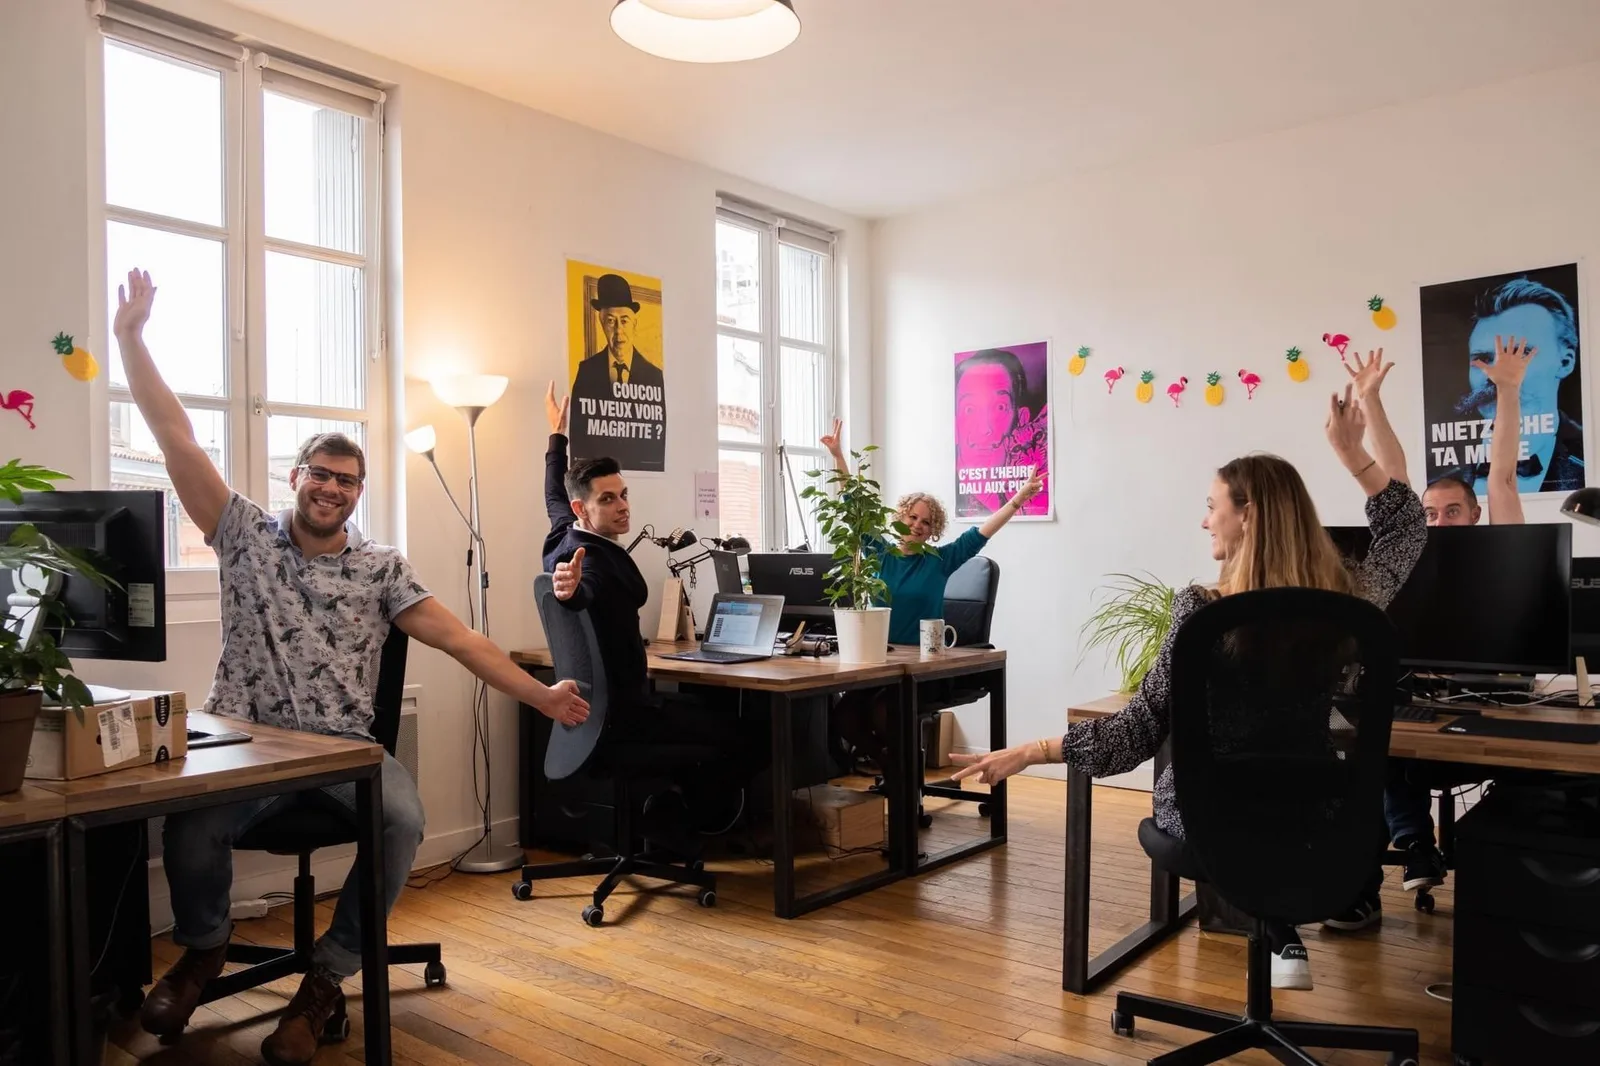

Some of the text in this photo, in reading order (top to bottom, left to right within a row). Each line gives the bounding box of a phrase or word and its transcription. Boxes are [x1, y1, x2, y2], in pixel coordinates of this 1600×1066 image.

[613, 382, 662, 402] COUCOU
[579, 398, 663, 421] TU VEUX VOIR
[587, 418, 652, 439] MAGRITTE
[1431, 413, 1554, 442] NIETZHE
[1431, 439, 1530, 467] TA ME
[959, 467, 988, 481] C'EST
[959, 481, 983, 495] DALI
[984, 481, 1006, 493] AUX
[789, 567, 814, 576] ASUS
